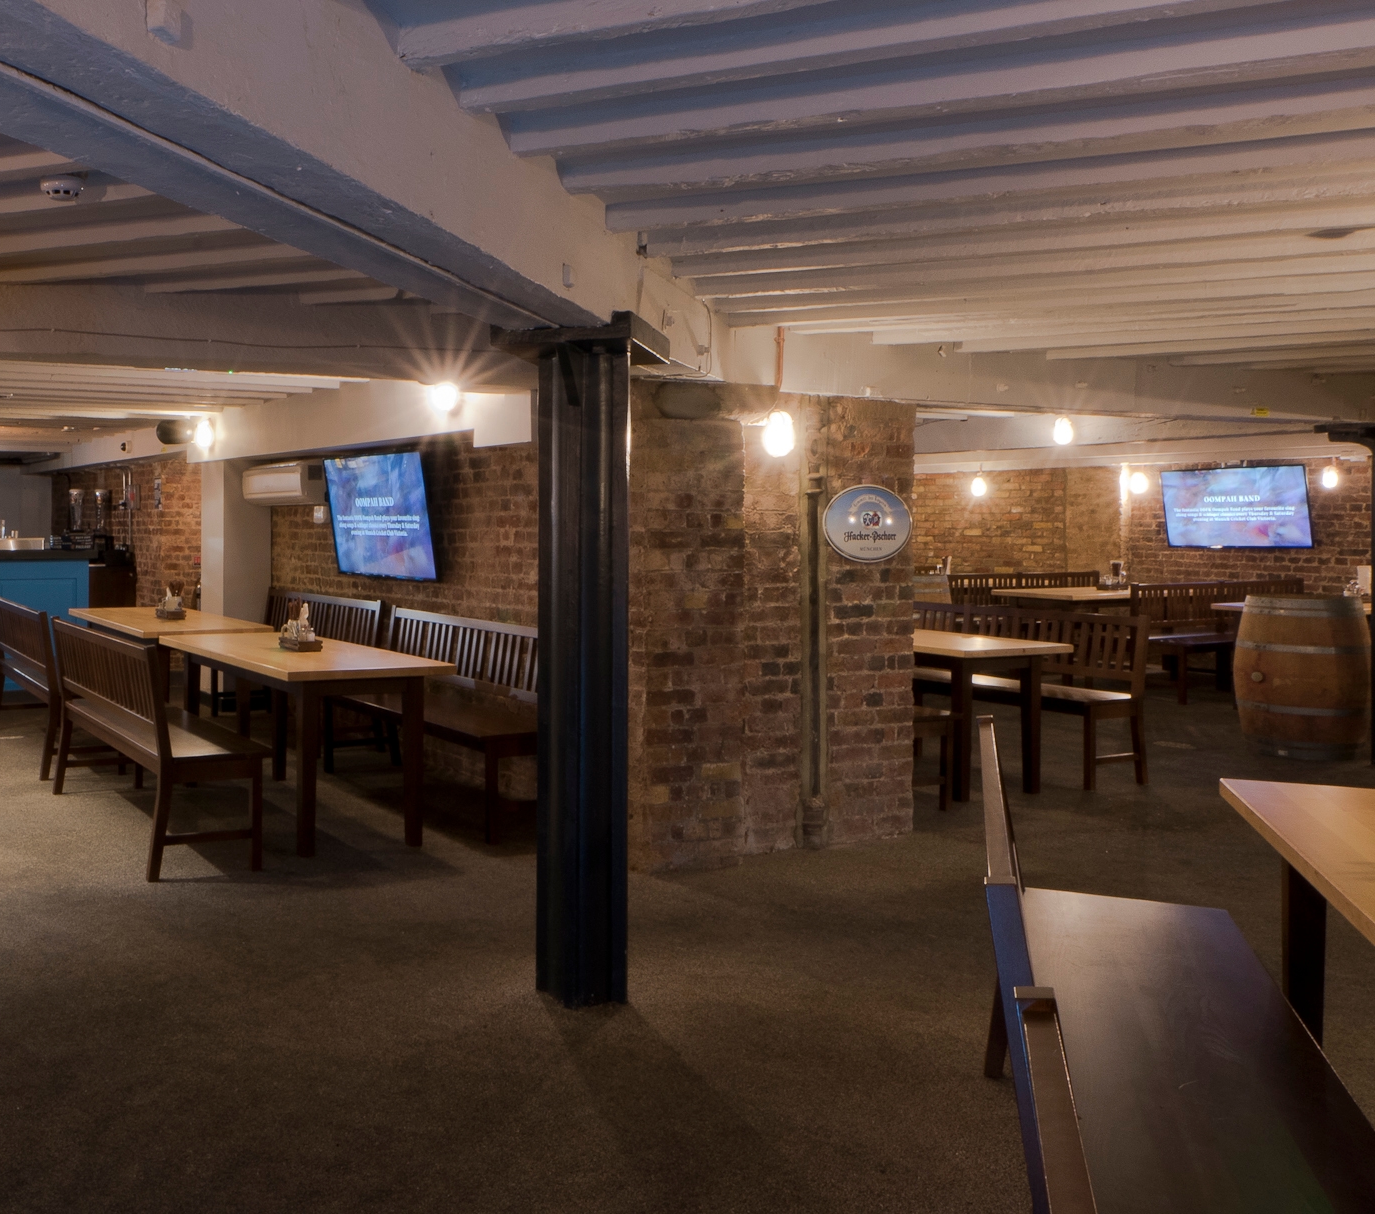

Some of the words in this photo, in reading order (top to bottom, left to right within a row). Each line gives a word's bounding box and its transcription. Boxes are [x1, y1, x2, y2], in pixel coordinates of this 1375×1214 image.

[355, 497, 378, 507] OOMPAH
[378, 496, 394, 506] BAND
[1203, 495, 1237, 503] OOMPAH
[1238, 494, 1261, 502] BAND
[843, 530, 897, 543] Hacker-Pschorr
